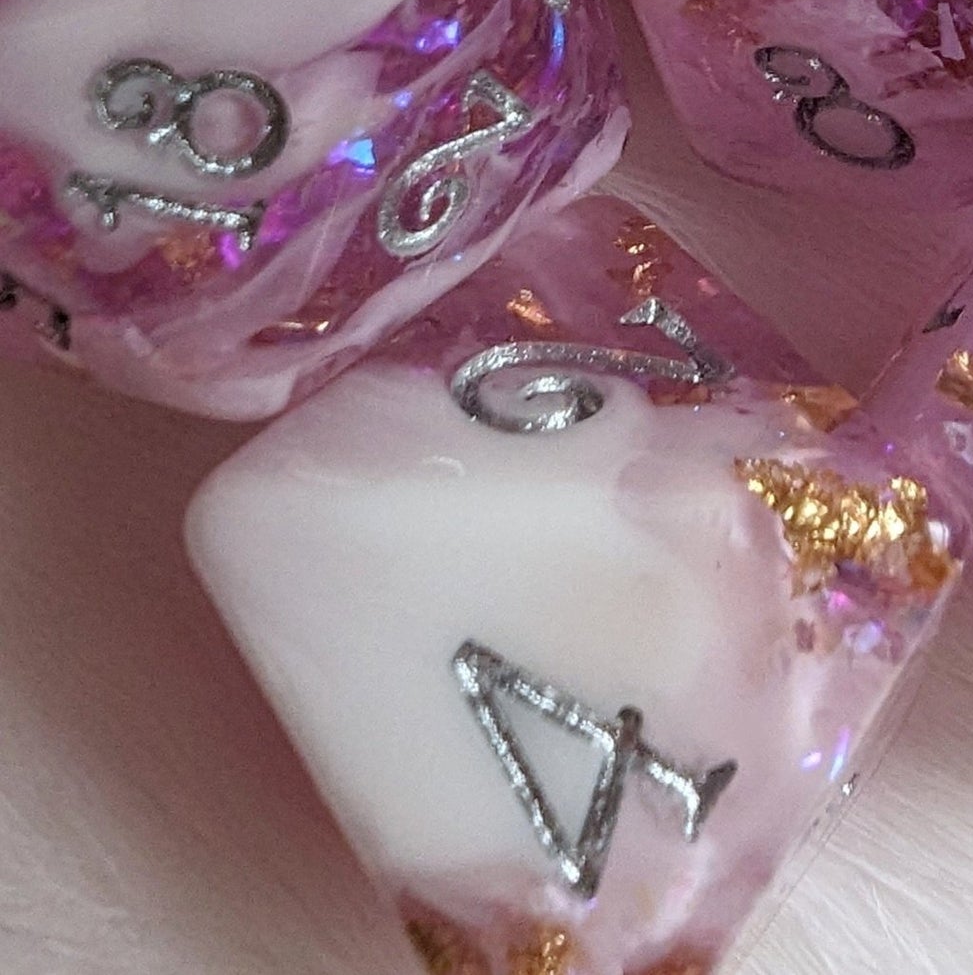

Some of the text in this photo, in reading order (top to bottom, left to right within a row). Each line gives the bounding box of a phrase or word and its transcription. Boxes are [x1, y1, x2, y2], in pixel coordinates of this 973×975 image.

[65, 57, 291, 252] 18
[754, 45, 916, 170] 8
[450, 638, 739, 899] 4
